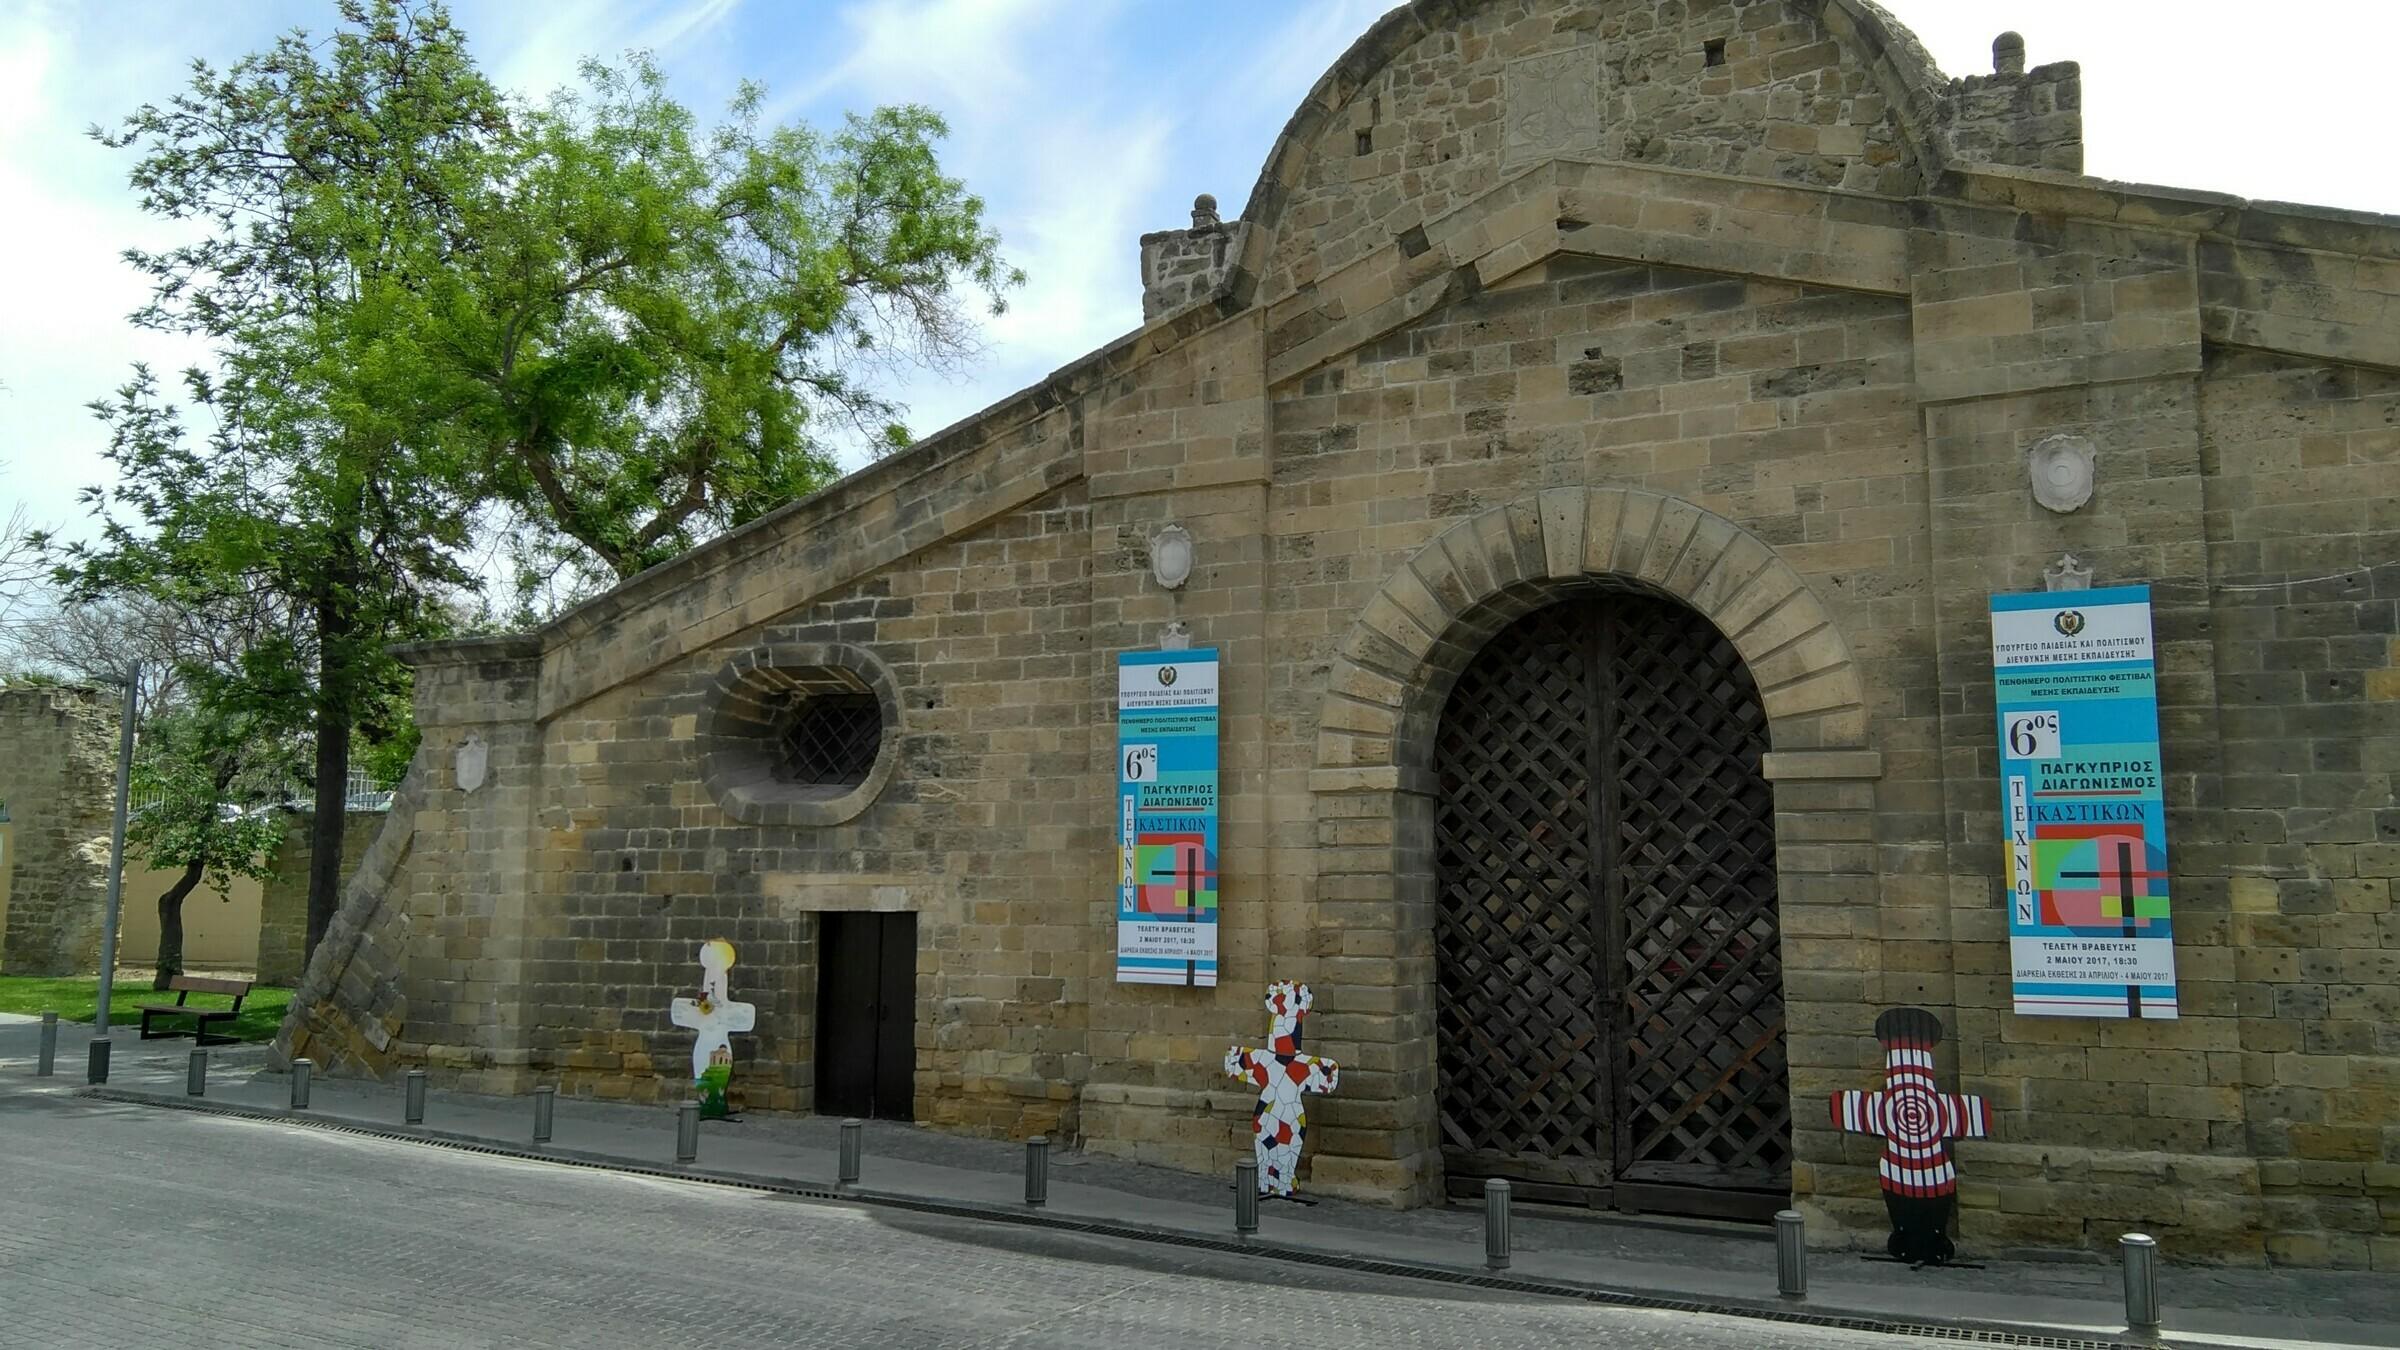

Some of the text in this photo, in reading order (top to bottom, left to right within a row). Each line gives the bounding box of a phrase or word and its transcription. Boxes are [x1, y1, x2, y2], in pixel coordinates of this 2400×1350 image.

[1996, 637, 2145, 652] ΥΠΟΥΡΓΕΙΟ ΠΑΙΔΕΙΑΣ ΚΑΙ ΠΟΛΙΤΙΣΜΟΥ
[2006, 650, 2136, 664] ΔΙΕΥΘΥΝΣΗ ΜΕΣΗΣ ΕΚΠΑΙΔΕΥΣΗΣ
[2000, 672, 2152, 686] ΠΕΝΘΗΜΕΡΟ ΠΟΛΙΤΙΣΤΙΚΟ ΦΕΣΤΙΒΑΛ
[2031, 686, 2120, 696] ΜΕΣΗΣ ΕΚΠΑΙΔΕΥΣΗΣ
[2041, 761, 2153, 774] ΠΑΓΚΥΠΡΙΟΣ
[2042, 776, 2156, 790] ΔΙΑΓΩΝΙΣΜΟΣ
[1144, 784, 1213, 794] ΠΑΓΚΥΠΡΙΟΣ
[1144, 797, 1214, 806] ΔΙΑΓΩΝΙΣΜΟΣ
[2042, 942, 2137, 951] ΤΕΛΕΤΗ ΒΡΑΒΕΥΣΗΣ
[2086, 957, 2110, 966] 2017,
[2016, 970, 2046, 978] ΔΙΑΡΚΕΙΑ
